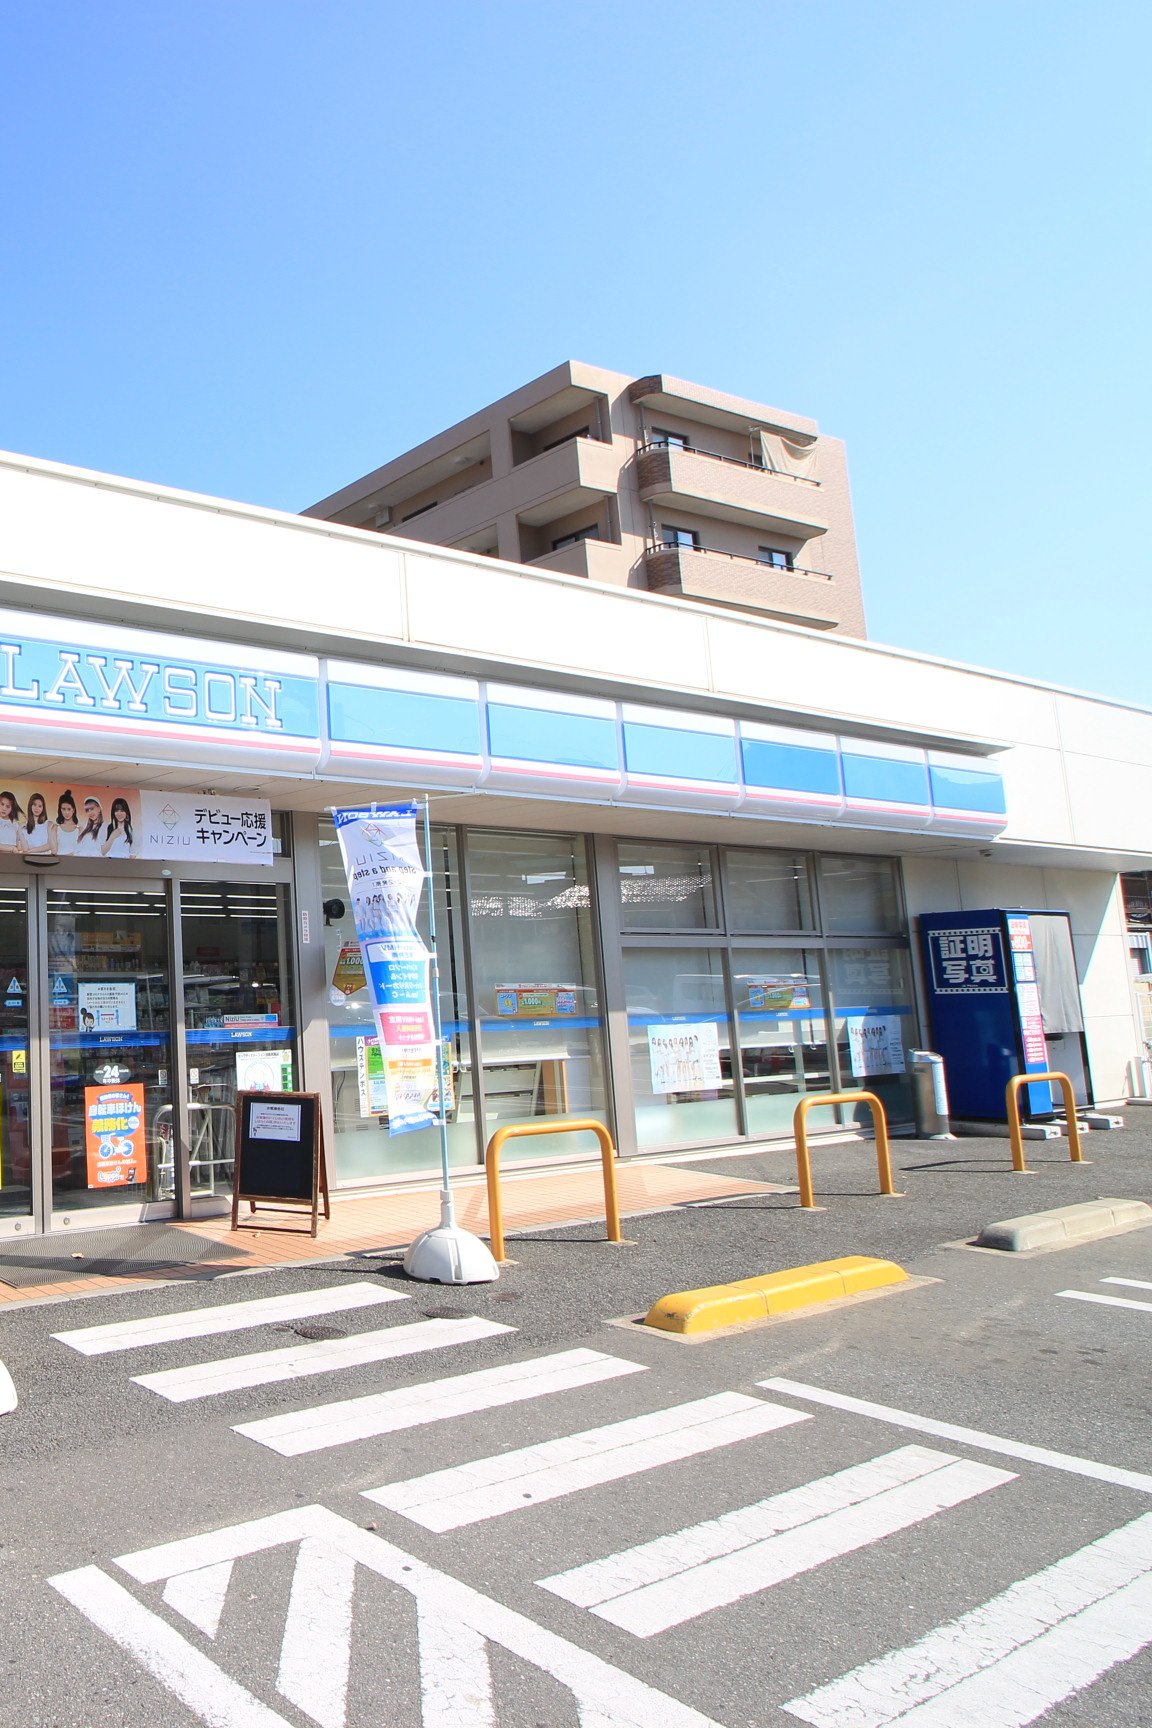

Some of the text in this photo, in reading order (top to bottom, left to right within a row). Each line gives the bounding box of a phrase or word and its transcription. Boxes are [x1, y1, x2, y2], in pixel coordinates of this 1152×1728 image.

[0, 642, 283, 728] LAWSON
[195, 808, 266, 829] デビュー応援
[150, 835, 191, 845] NIZIU
[196, 828, 266, 847] キャンペーン
[939, 934, 993, 958] 証明
[942, 958, 997, 983] 写真
[103, 1065, 119, 1078] 24
[357, 1038, 366, 1096] ハウステンボス
[89, 1102, 141, 1116] 自転車ほけん
